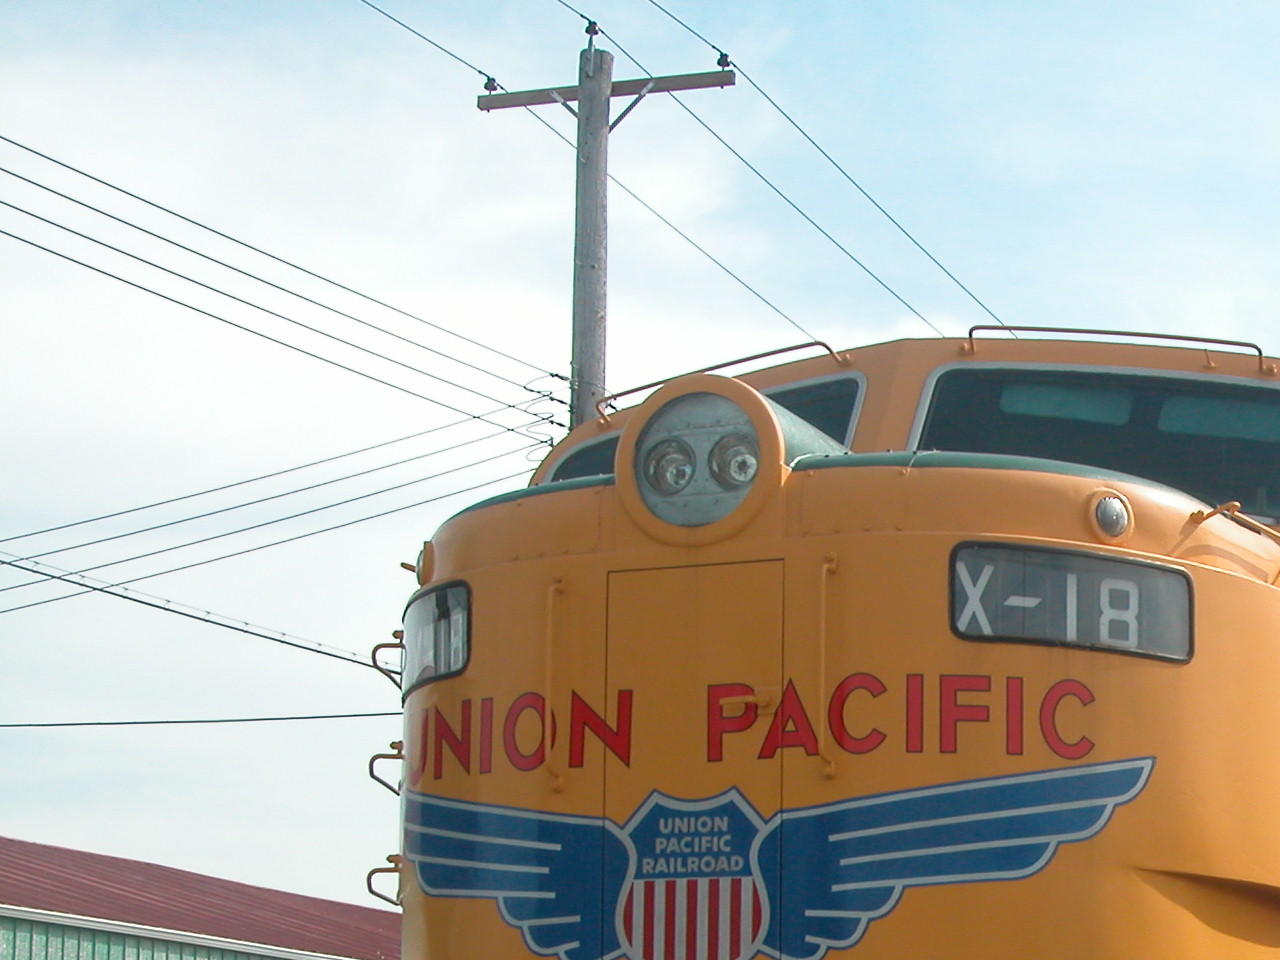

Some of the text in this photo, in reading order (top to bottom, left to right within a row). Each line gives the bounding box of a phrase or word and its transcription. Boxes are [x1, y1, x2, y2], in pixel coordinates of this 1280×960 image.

[956, 560, 1139, 648] X-18
[707, 673, 1096, 762] PACIFIC
[659, 816, 729, 834] UNION
[655, 835, 732, 854] PACIFIC
[642, 855, 745, 874] RAILROAD
